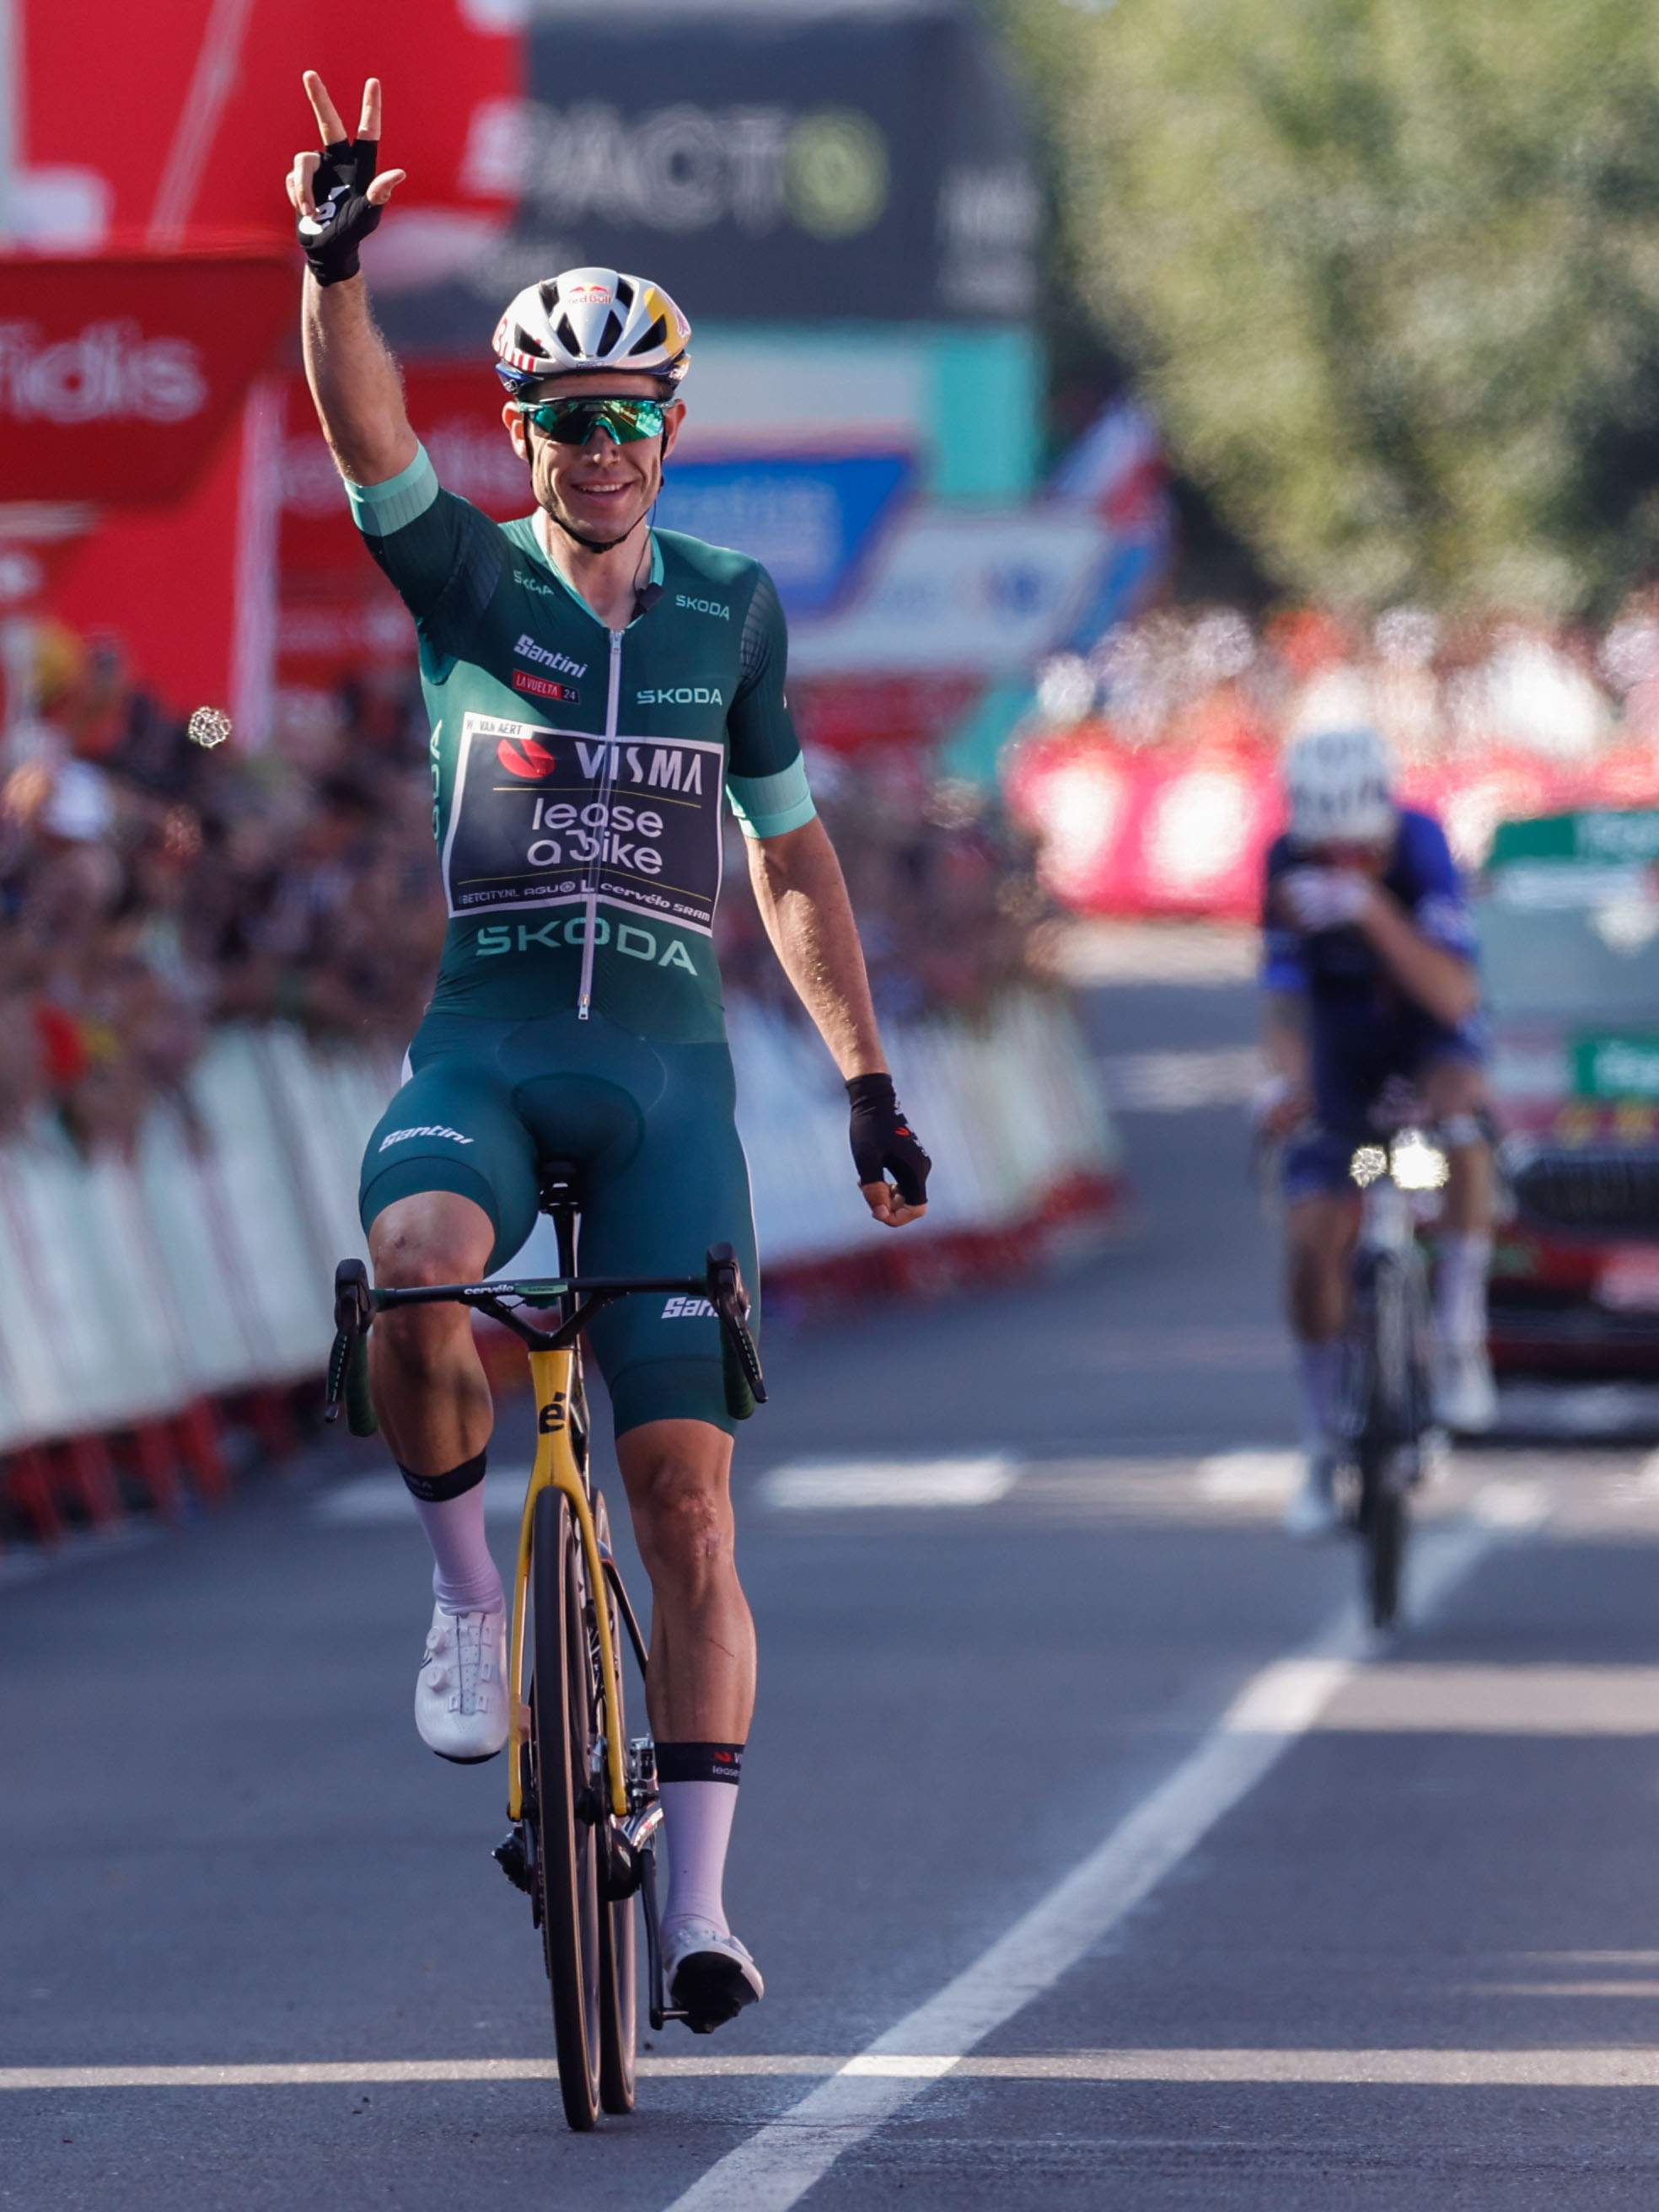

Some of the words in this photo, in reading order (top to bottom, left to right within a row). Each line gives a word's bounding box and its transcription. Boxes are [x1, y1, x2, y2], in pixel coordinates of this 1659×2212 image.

[675, 594, 730, 620] SKODA
[513, 634, 588, 678] Santini
[527, 677, 558, 696] VUELTA
[563, 688, 576, 700] 24
[636, 688, 722, 706] SKODA
[575, 742, 702, 795] VISMA
[532, 798, 663, 838] lease
[527, 840, 561, 866] a
[600, 883, 671, 909] cervélo
[673, 903, 711, 922] SRAM
[475, 916, 698, 976] SKODA
[379, 1125, 475, 1152] Santini
